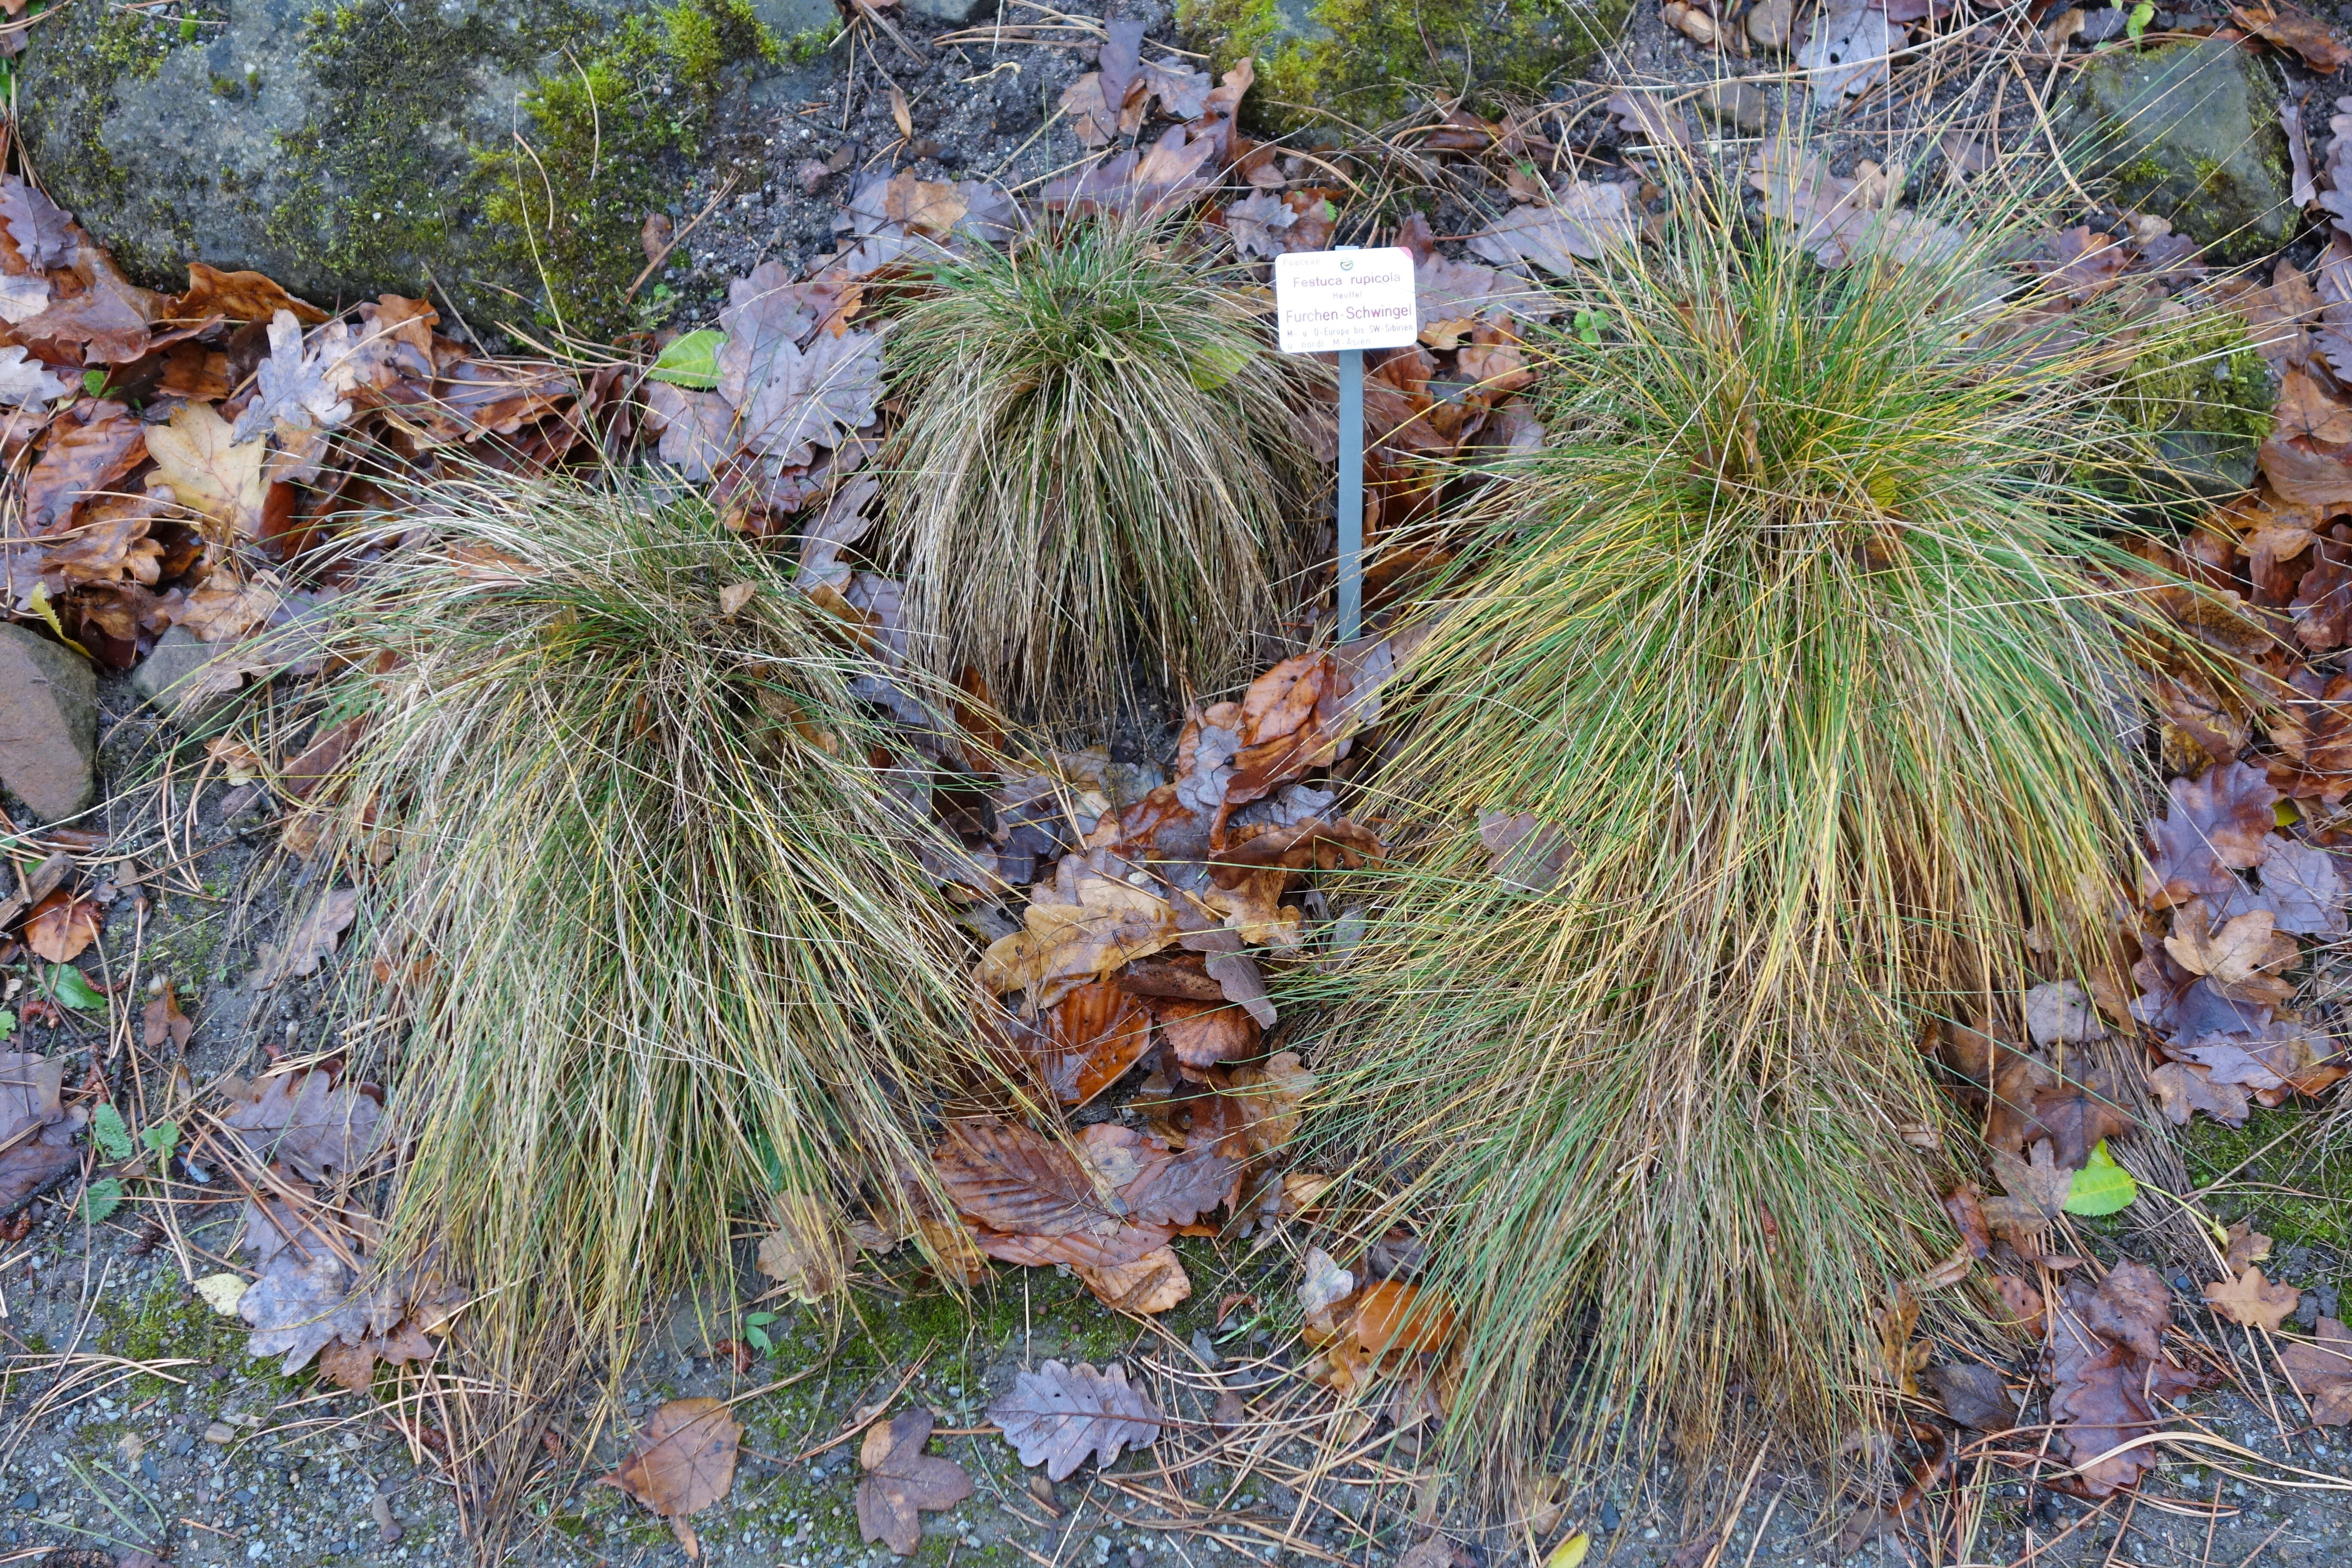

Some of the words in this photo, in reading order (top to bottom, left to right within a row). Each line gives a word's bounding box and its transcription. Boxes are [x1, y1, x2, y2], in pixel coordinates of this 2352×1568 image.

[1293, 276, 1342, 288] Festuca
[1351, 272, 1401, 286] rupicola
[1286, 303, 1412, 323] Furchen-Schwingel
[1354, 325, 1364, 334] bis
[1369, 324, 1413, 333] SW-Sibirien
